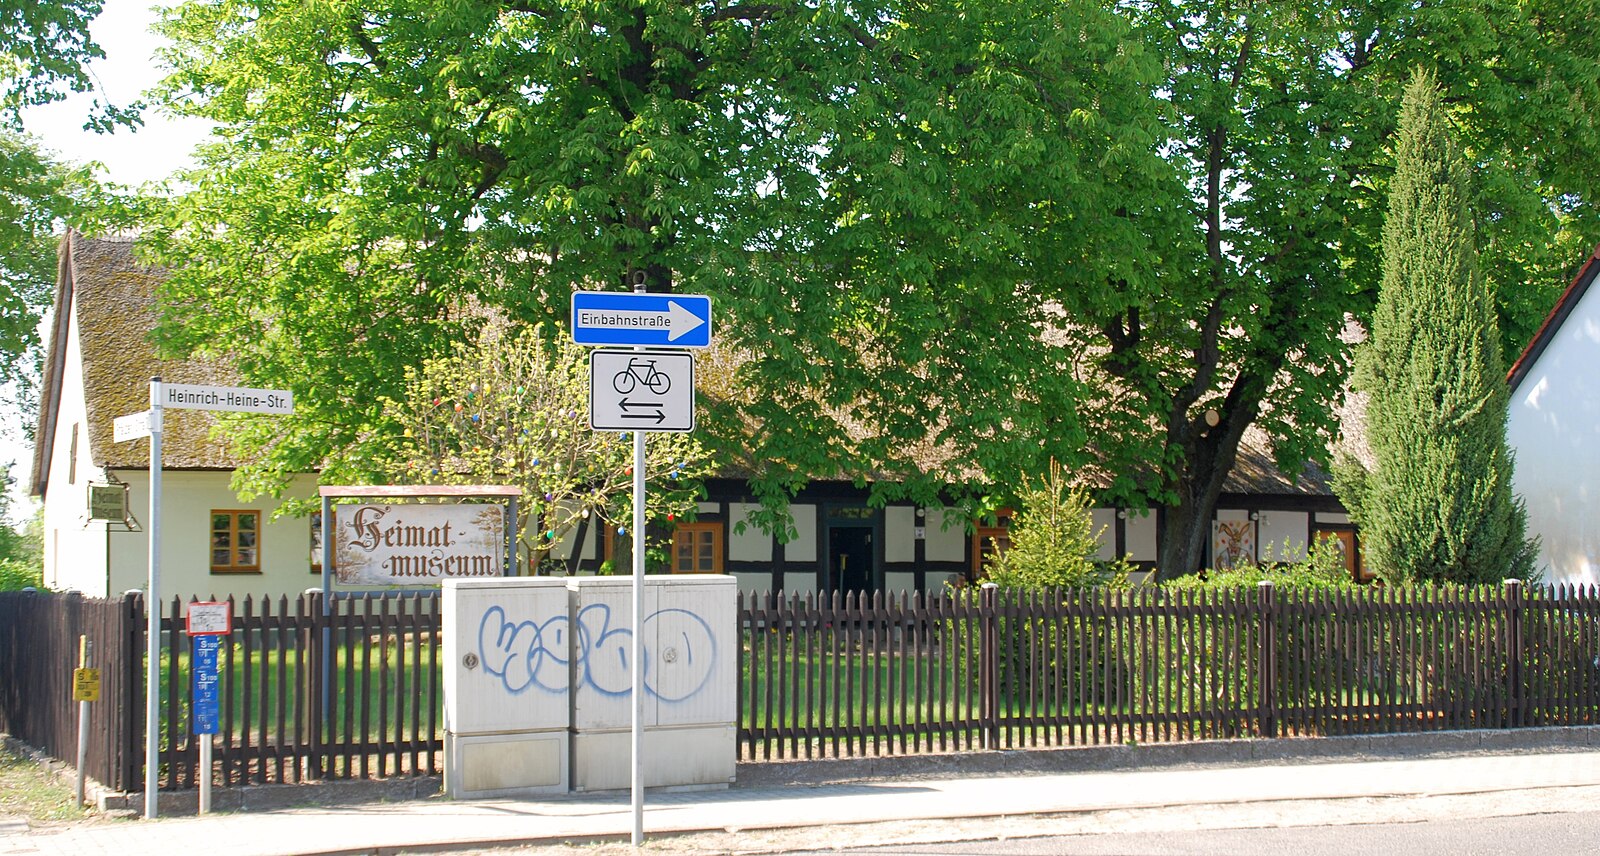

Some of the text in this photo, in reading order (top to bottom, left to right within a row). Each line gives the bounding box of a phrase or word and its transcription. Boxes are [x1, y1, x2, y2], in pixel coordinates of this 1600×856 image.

[581, 313, 671, 327] Einbahnstraße
[168, 388, 288, 409] Heinrich-Heine-Str.
[382, 549, 495, 577] museum
